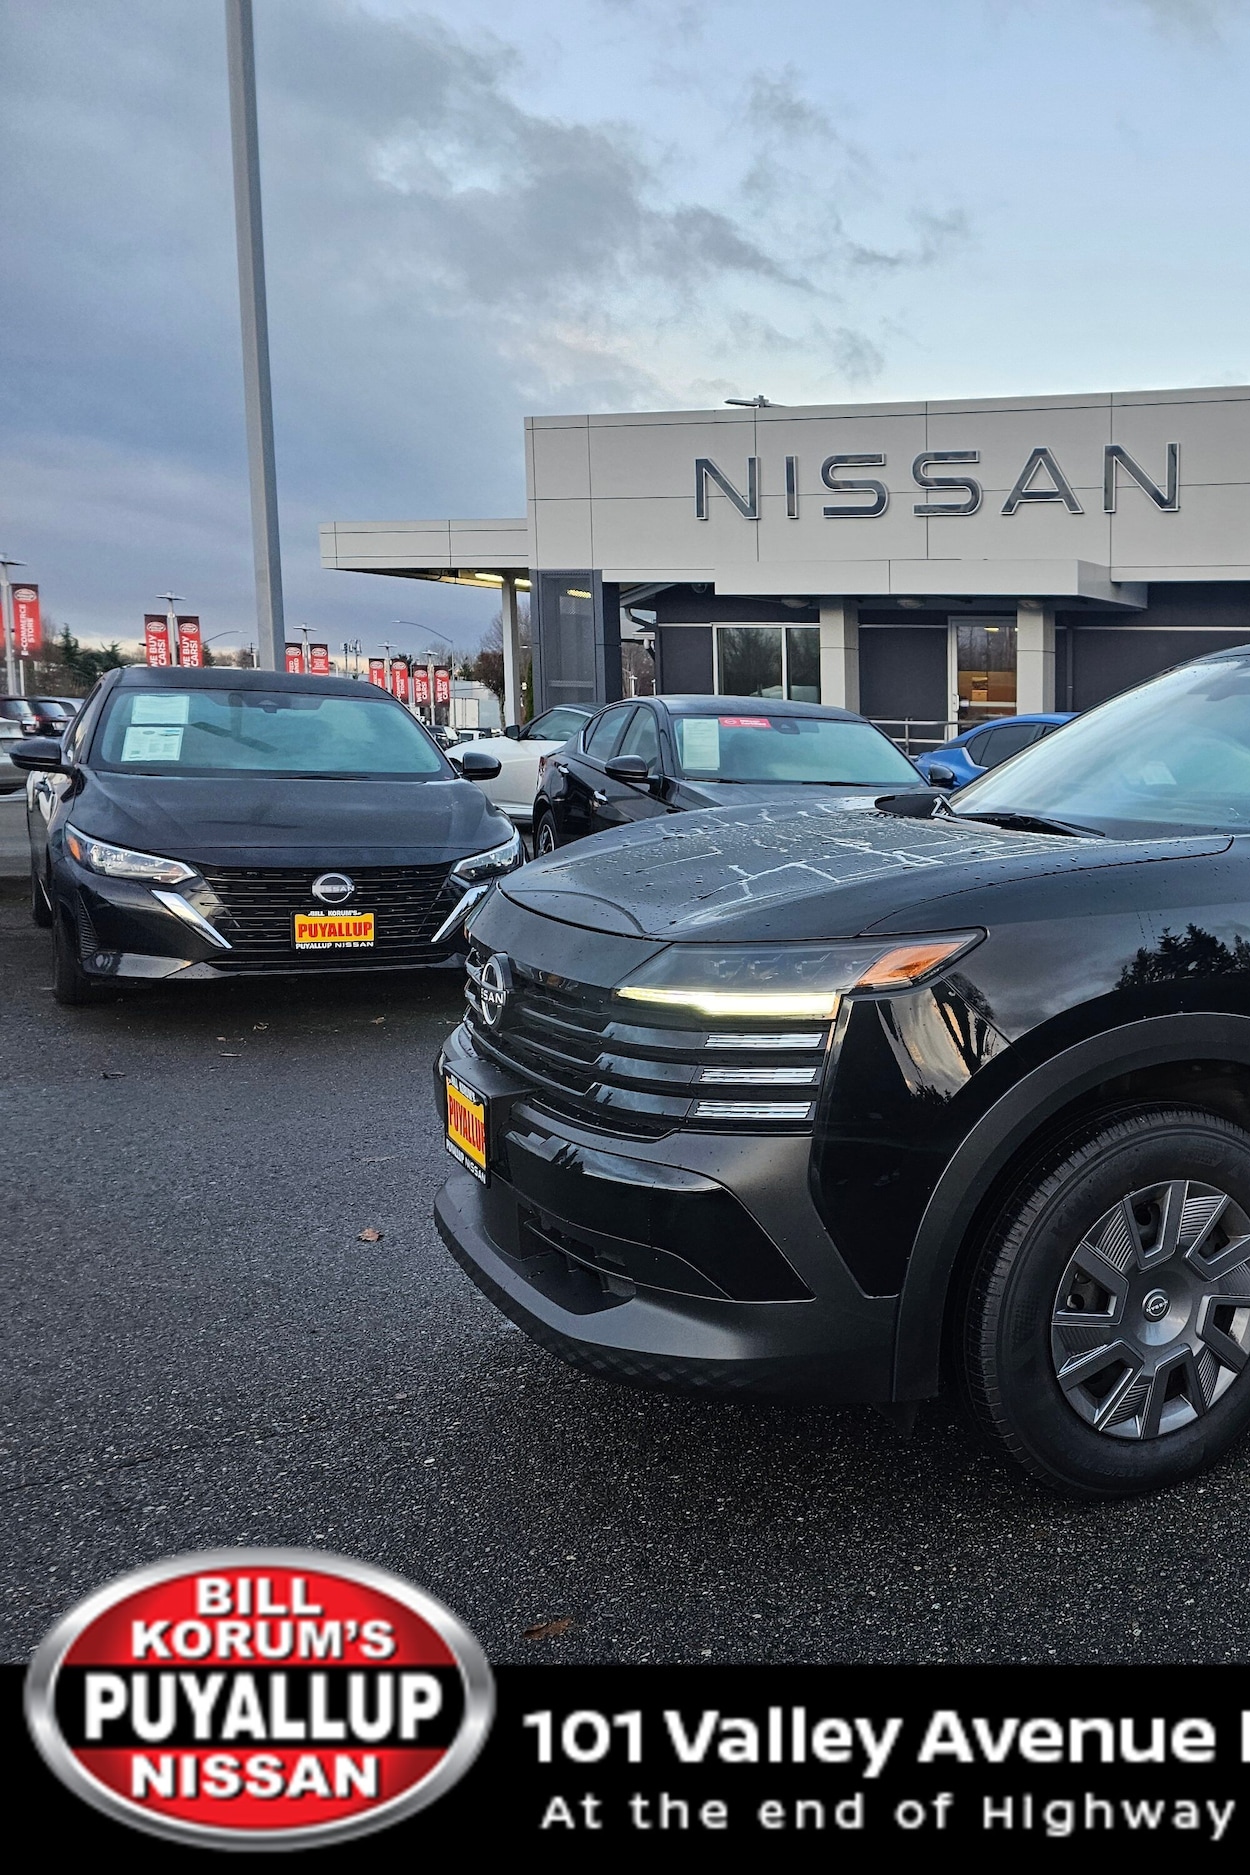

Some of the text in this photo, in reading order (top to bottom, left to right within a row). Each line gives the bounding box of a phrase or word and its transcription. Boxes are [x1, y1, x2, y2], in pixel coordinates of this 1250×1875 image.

[694, 442, 1182, 521] NISSAN
[27, 617, 35, 643] STORE
[148, 634, 158, 654] BUY
[157, 639, 167, 666] CARS!
[181, 635, 190, 655] BUY
[189, 640, 199, 667] CARS!
[298, 922, 372, 938] PUYALLUP
[449, 1095, 485, 1154] PUYALLUP
